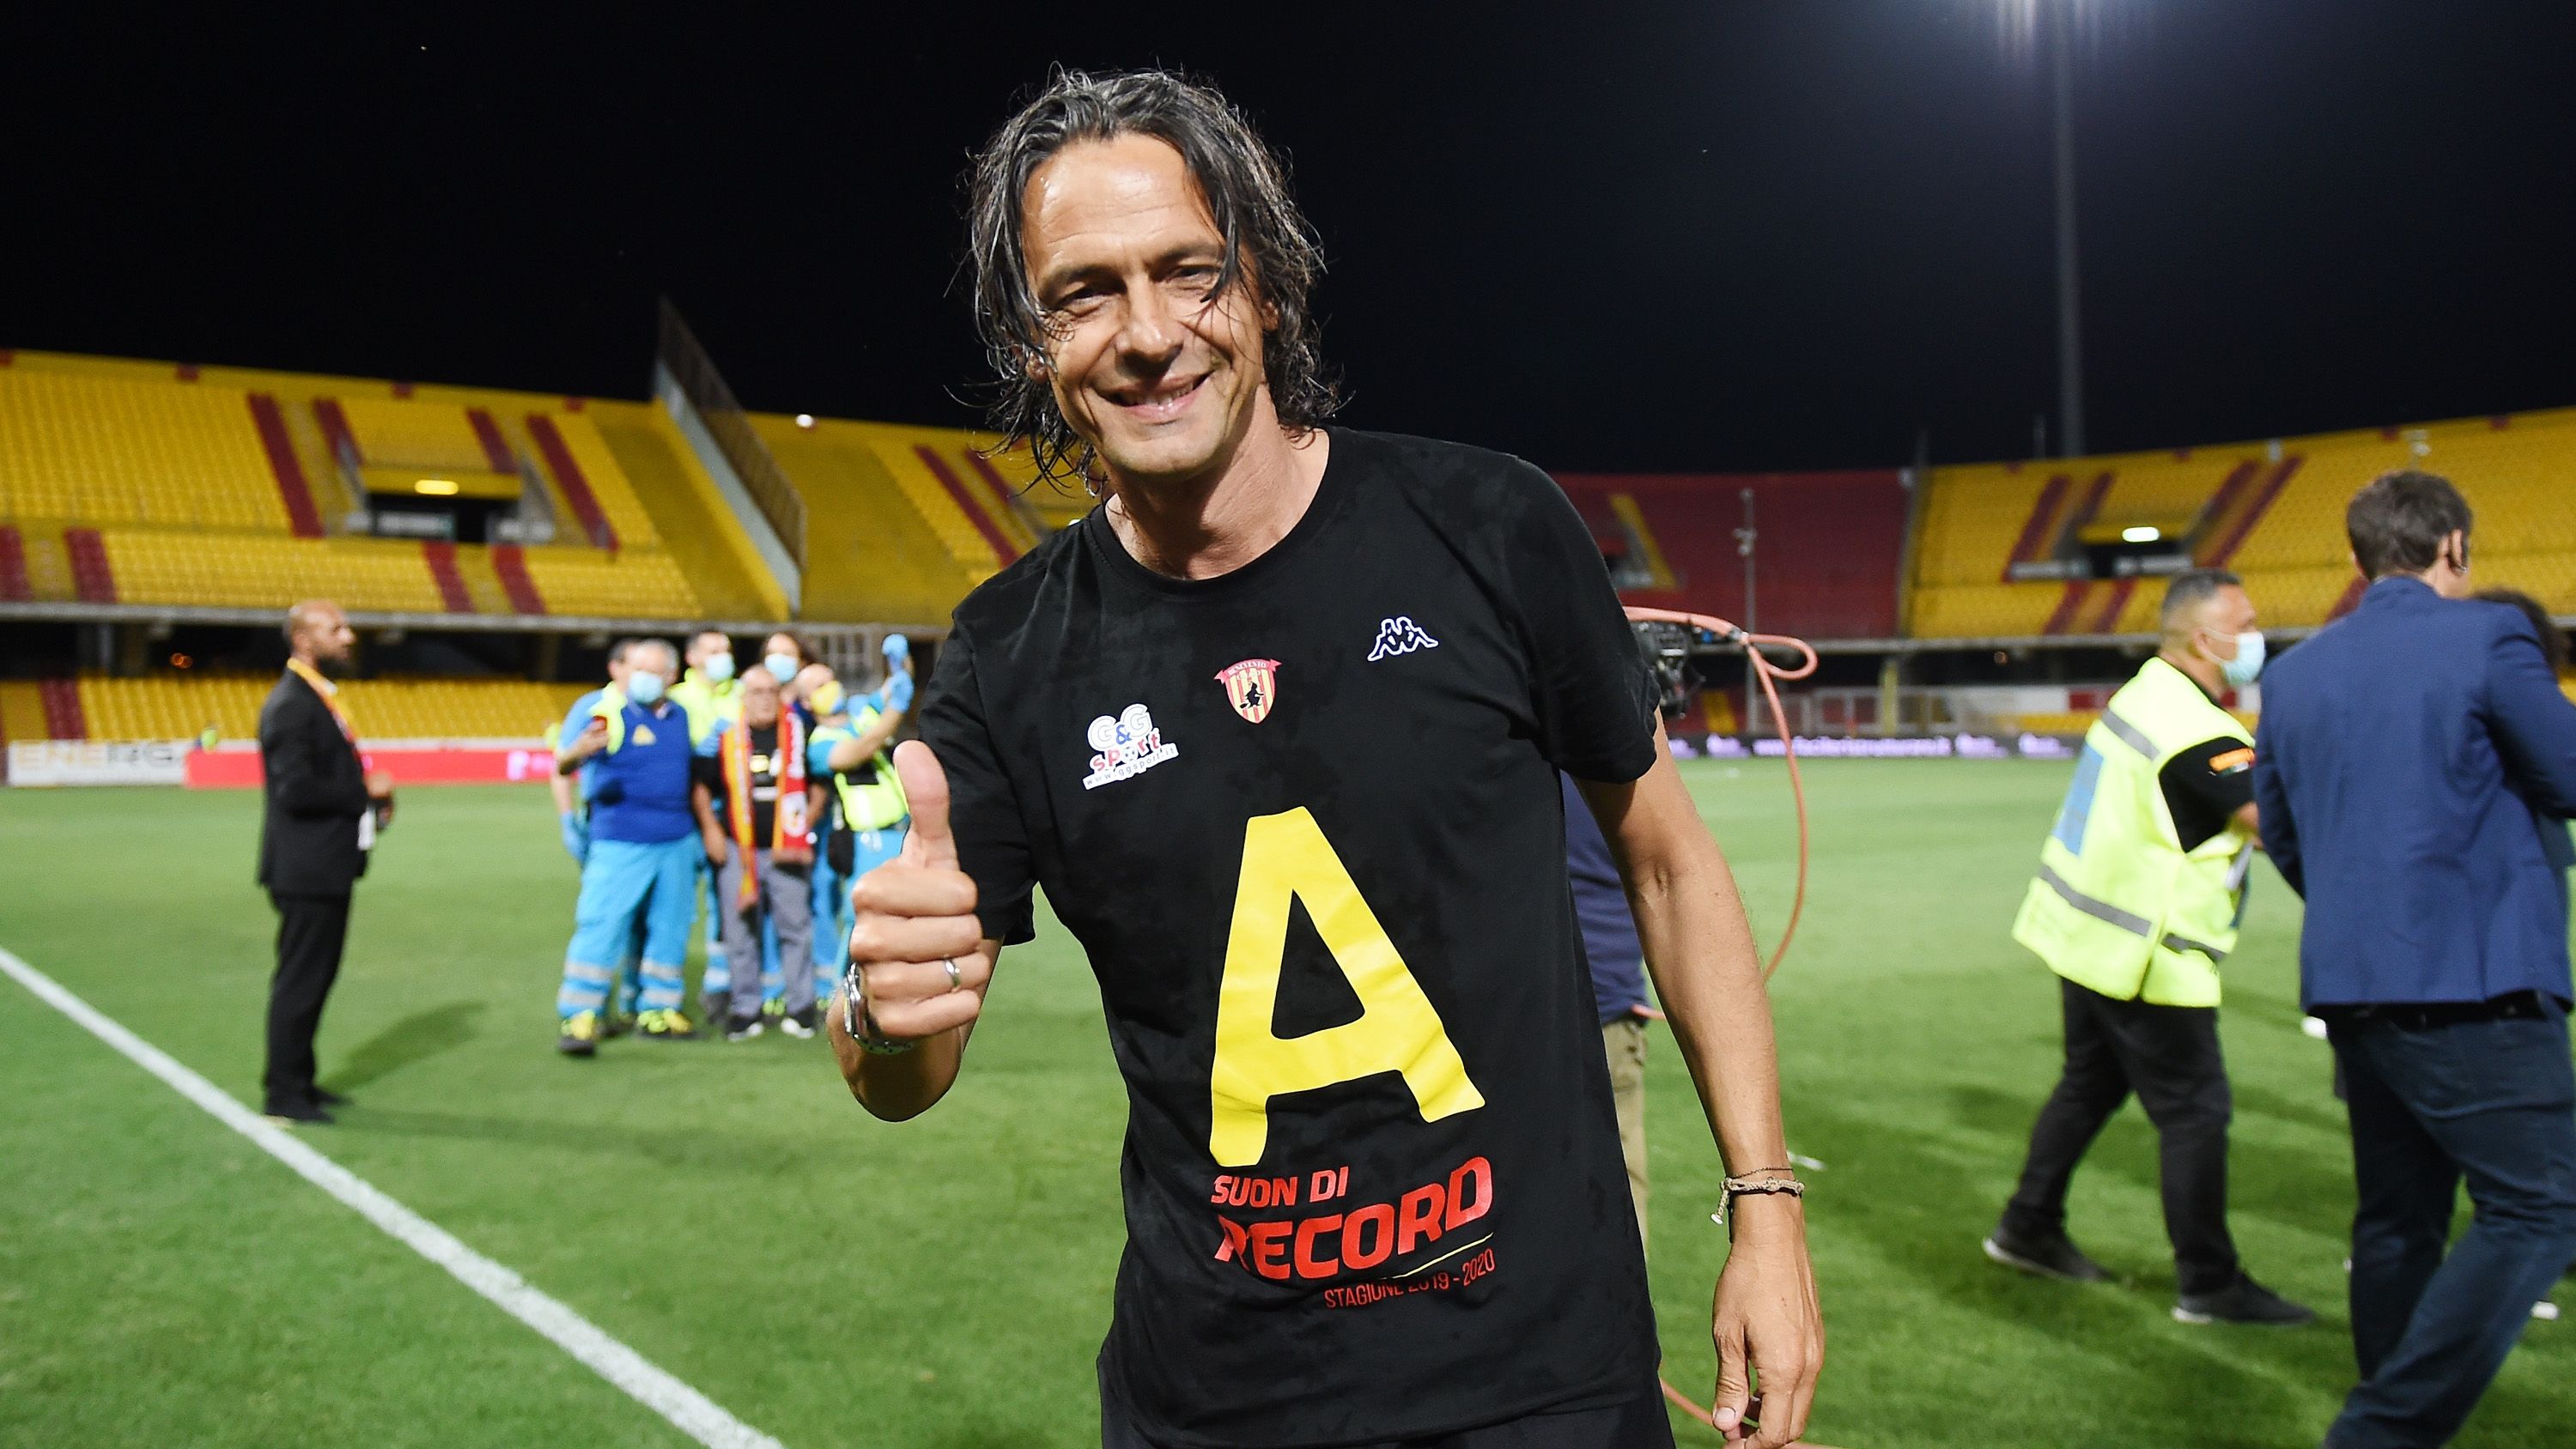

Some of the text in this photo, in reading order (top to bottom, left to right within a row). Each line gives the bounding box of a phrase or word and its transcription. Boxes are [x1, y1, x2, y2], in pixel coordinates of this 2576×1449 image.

[1089, 705, 1151, 749] G&G
[1209, 805, 1486, 1167] A
[1210, 1165, 1351, 1209] SUON DI
[1213, 1155, 1494, 1281] RECORD
[1461, 1247, 1496, 1288] 2020
